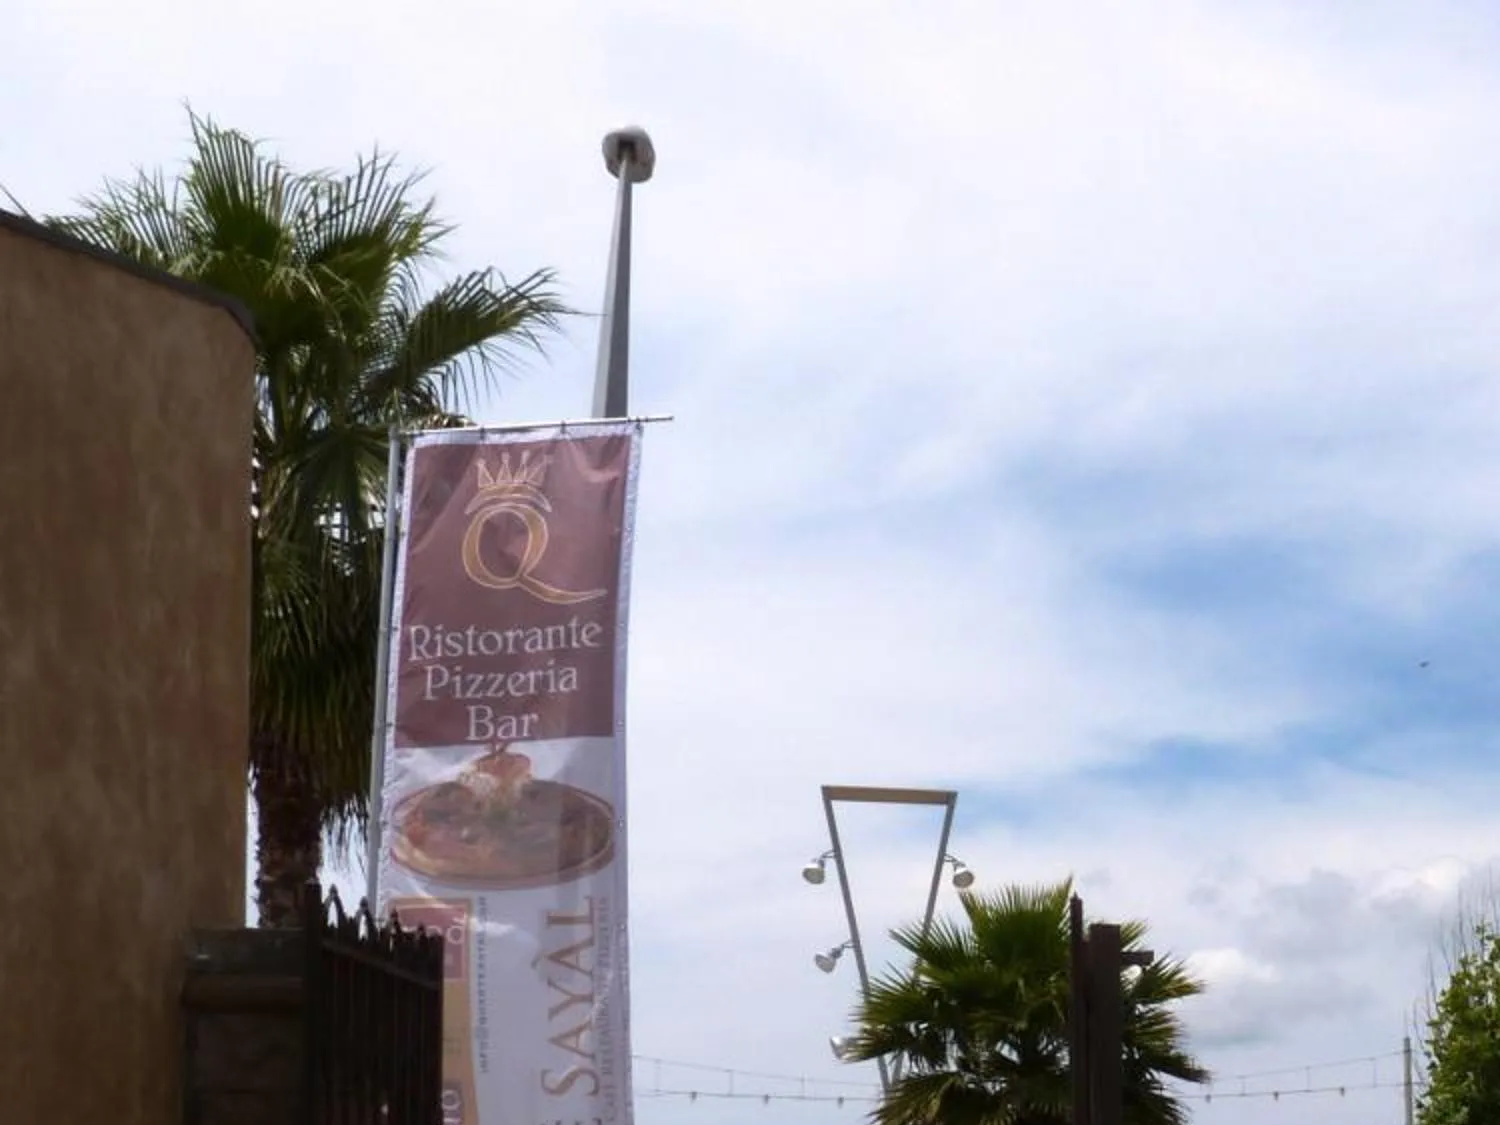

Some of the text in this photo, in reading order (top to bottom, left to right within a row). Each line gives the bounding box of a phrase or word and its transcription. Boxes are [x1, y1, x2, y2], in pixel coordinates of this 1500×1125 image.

[407, 617, 602, 661] Ristorante
[424, 660, 578, 701] Pizzeria
[466, 705, 540, 741] Bar
